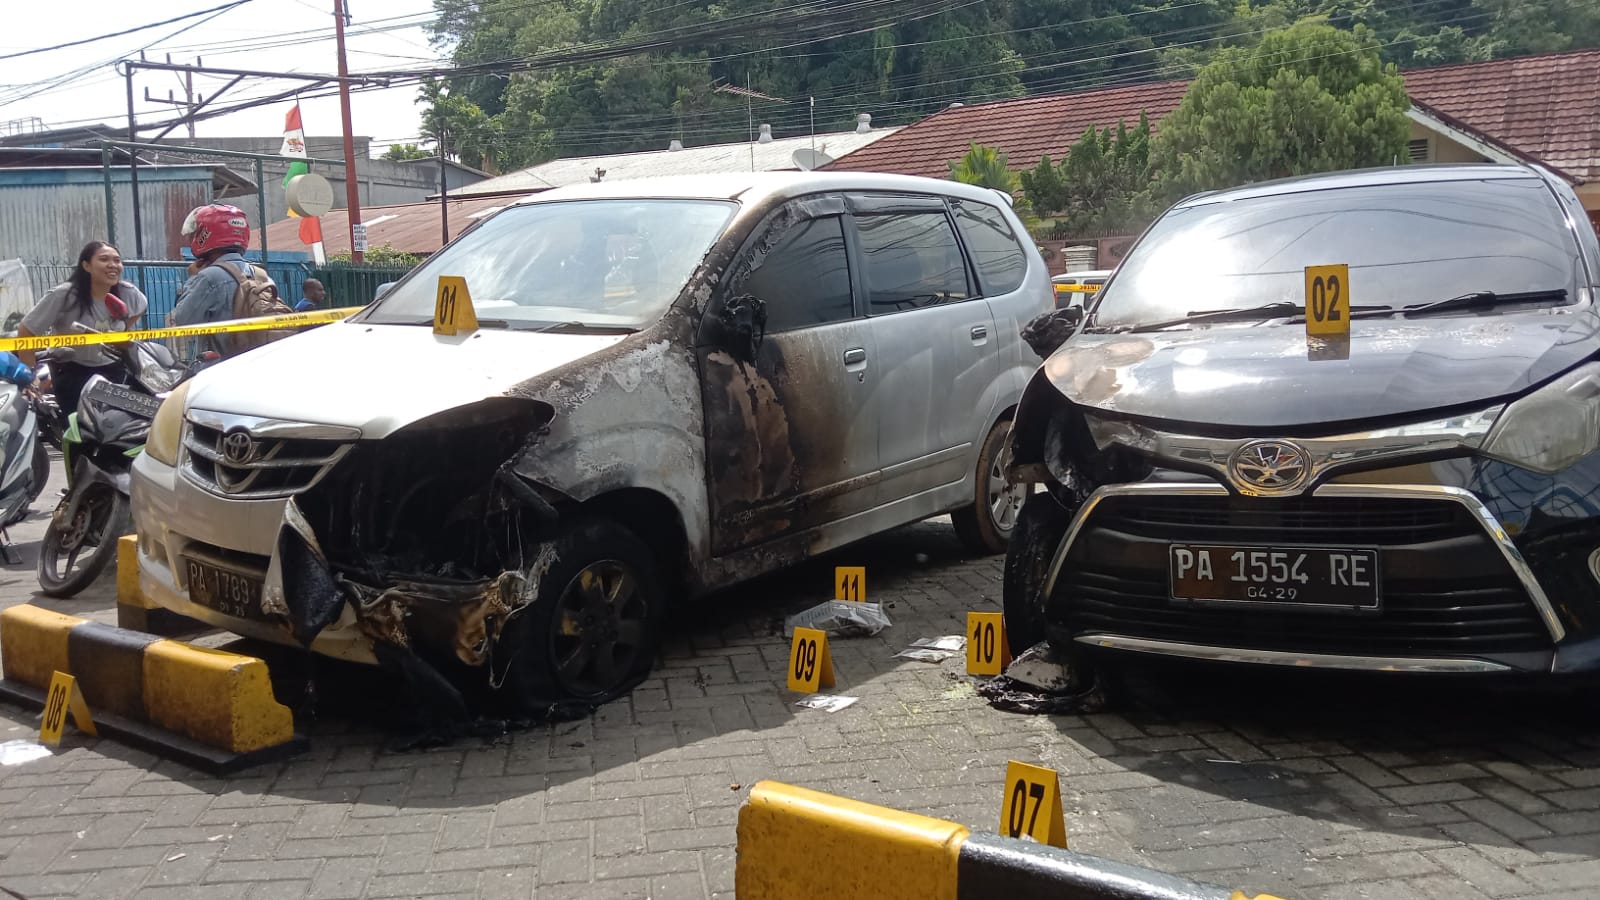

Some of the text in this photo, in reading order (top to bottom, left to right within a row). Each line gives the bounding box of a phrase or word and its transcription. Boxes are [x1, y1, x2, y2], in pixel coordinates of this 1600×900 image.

[439, 285, 457, 325] 01
[1312, 275, 1341, 323] 02
[190, 562, 206, 592] PA
[215, 570, 248, 603] 1789
[841, 573, 859, 601] 11
[1176, 548, 1371, 587] PA 1554 RE
[794, 637, 817, 682] 09
[973, 620, 994, 664] 10
[46, 683, 66, 732] 08
[1008, 778, 1046, 839] 07
